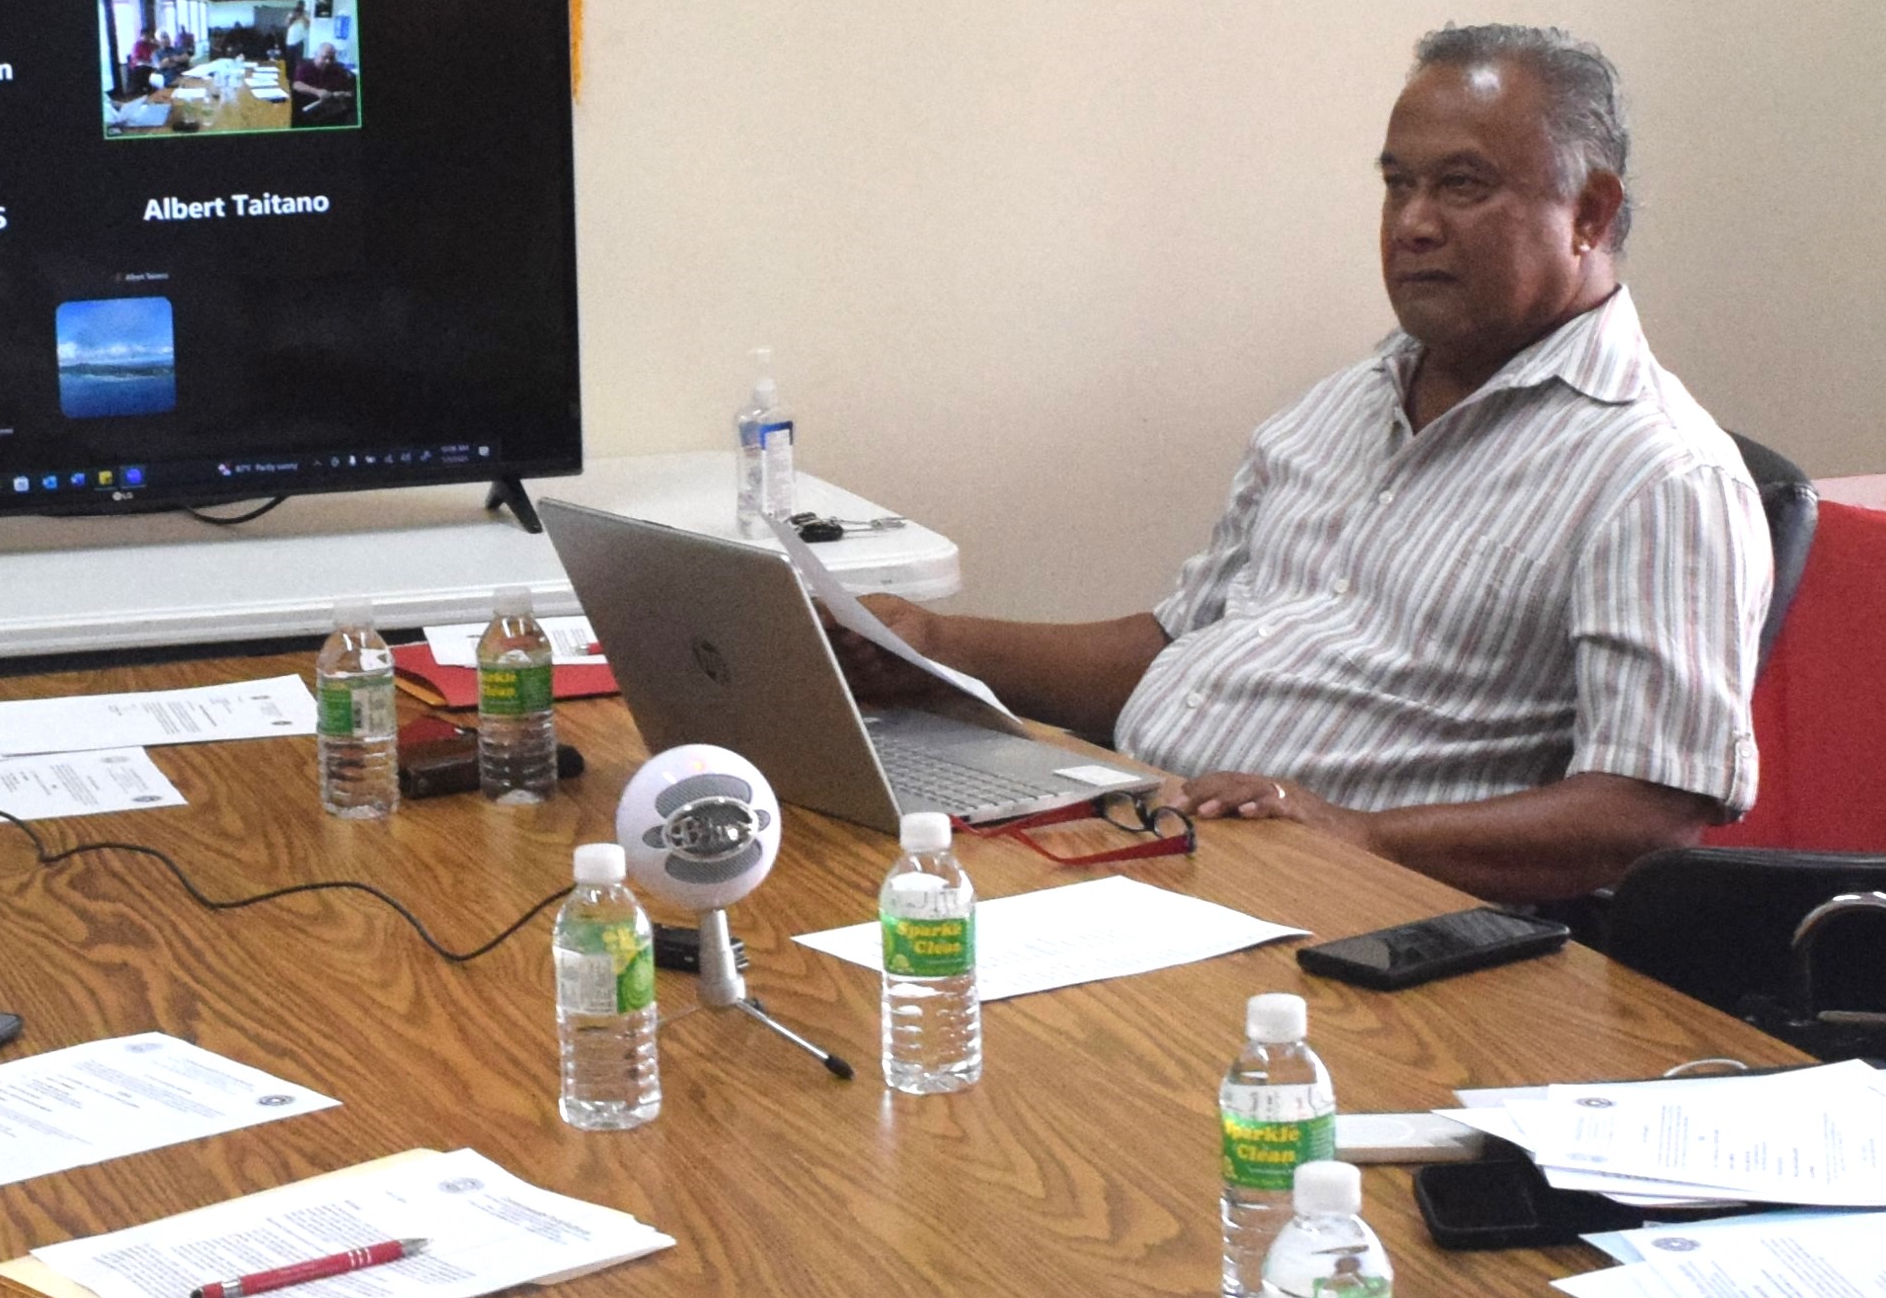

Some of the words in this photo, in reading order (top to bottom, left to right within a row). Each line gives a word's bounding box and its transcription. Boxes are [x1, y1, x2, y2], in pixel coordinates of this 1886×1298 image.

[143, 197, 226, 222] Albert
[232, 192, 330, 218] Taitano
[1236, 1143, 1296, 1164] Clean
